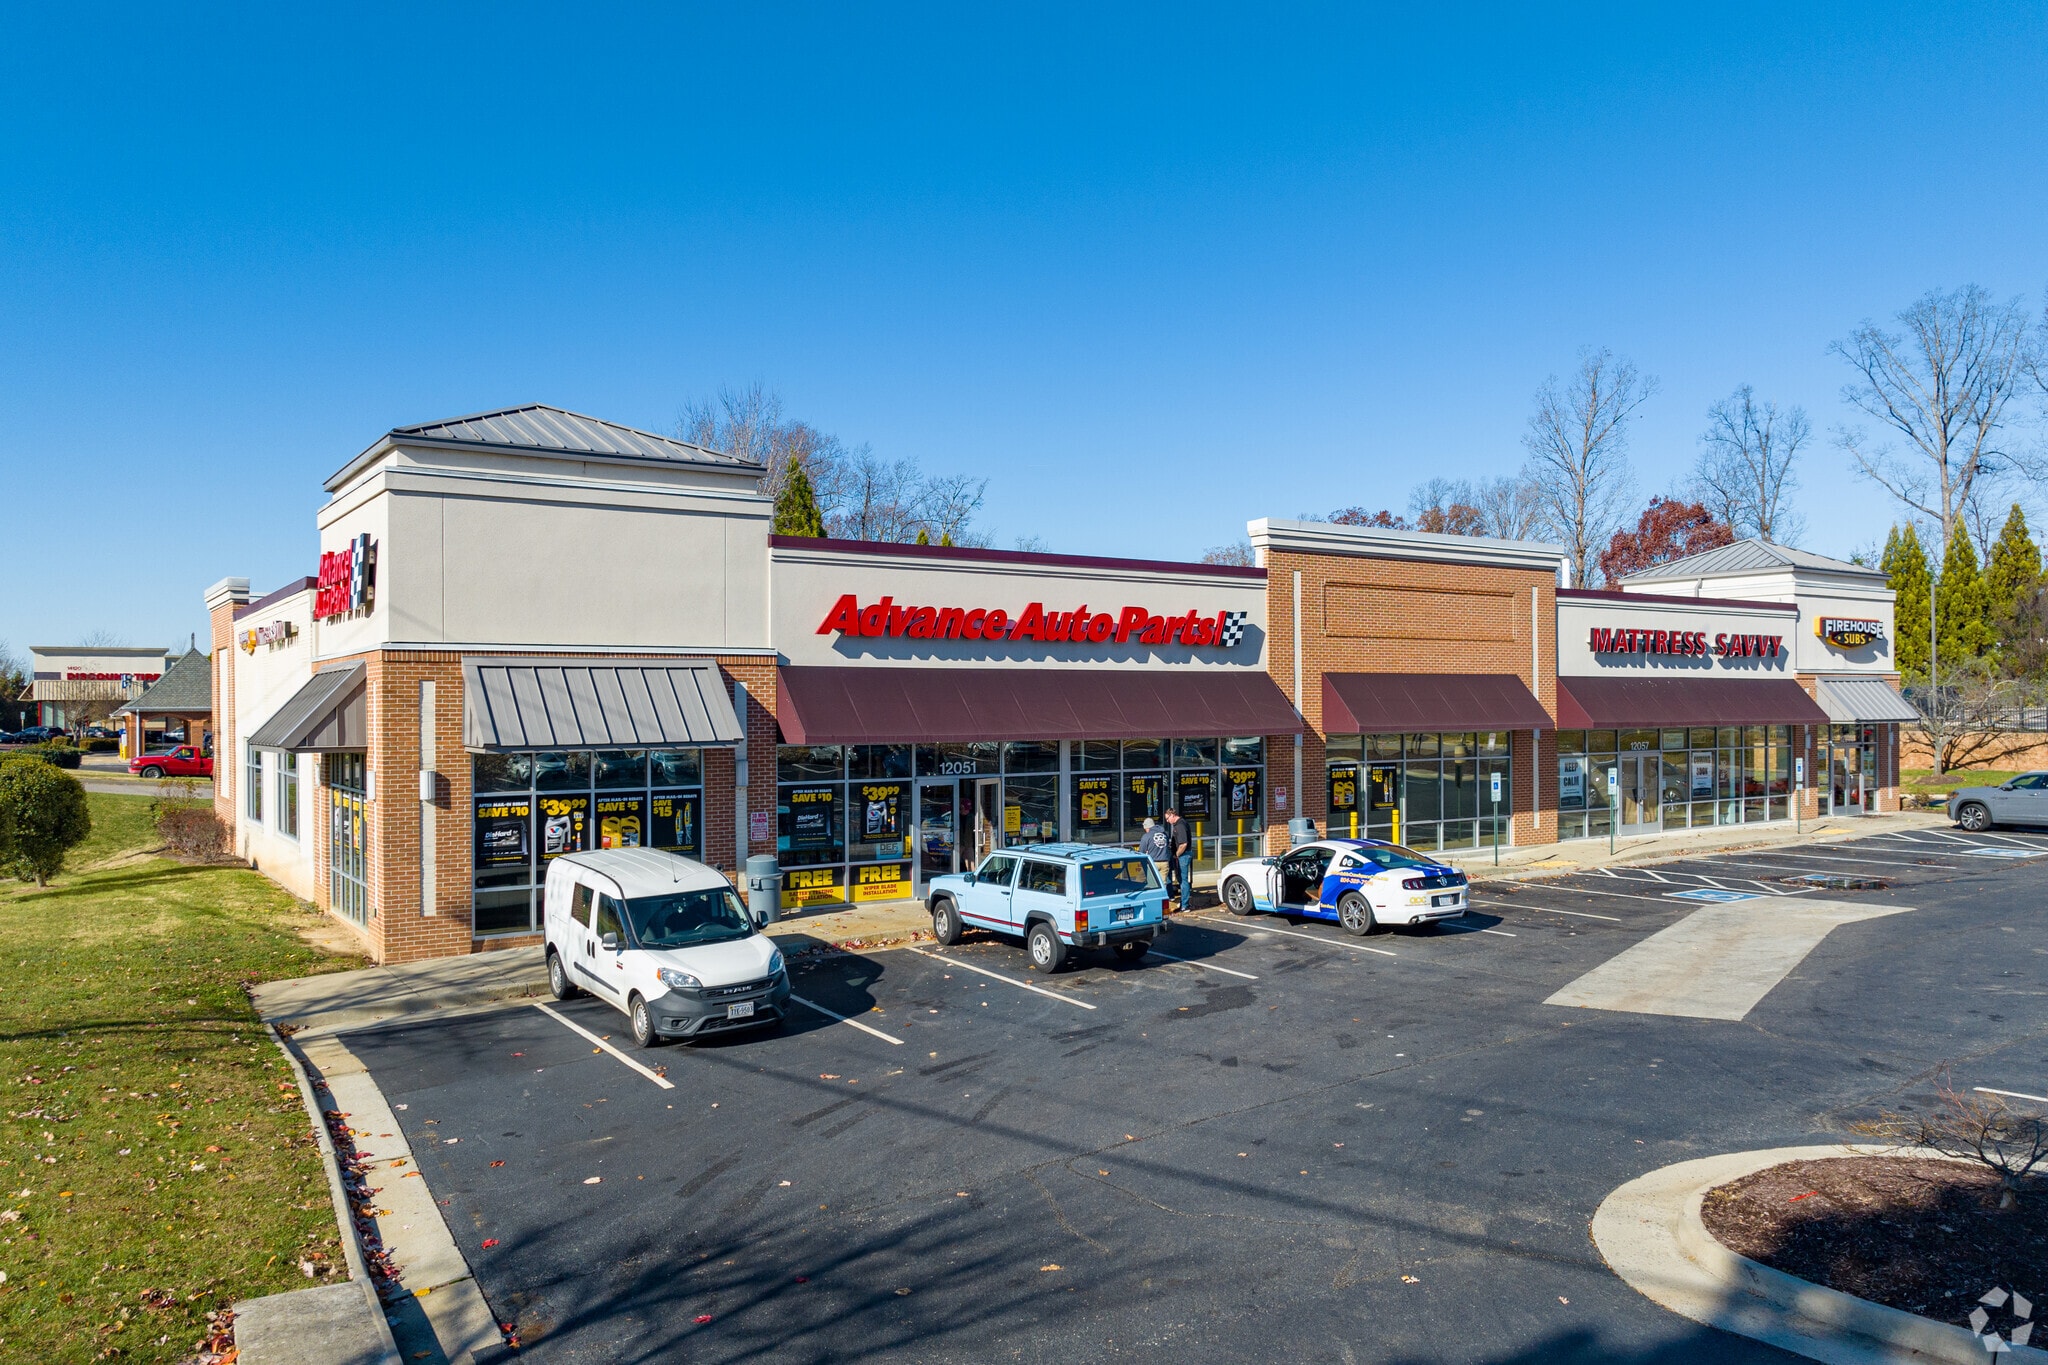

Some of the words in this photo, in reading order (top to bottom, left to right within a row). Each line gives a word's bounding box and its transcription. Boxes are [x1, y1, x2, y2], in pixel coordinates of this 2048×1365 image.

[315, 549, 351, 590] Advance
[815, 594, 1012, 640] Advance
[1008, 602, 1114, 643] Auto
[1825, 619, 1884, 639] FIREHOUSE
[1590, 627, 1707, 655] MATTRESS
[1715, 633, 1783, 657] SAVVY
[1843, 633, 1866, 645] SUBS
[1630, 741, 1649, 751] 12057
[940, 761, 977, 775] 12051
[1564, 762, 1578, 772] KEEP
[1348, 770, 1354, 778] $5
[1372, 775, 1383, 783] $15
[1080, 781, 1098, 790] SAVE
[1100, 781, 1107, 789] $5
[1181, 777, 1198, 785] SAVE
[1199, 776, 1209, 784] $10
[1563, 776, 1579, 786] CALM
[1132, 785, 1145, 793] $15
[653, 799, 672, 807] SAVE
[792, 794, 817, 803] SAVE
[817, 793, 833, 802] $10
[597, 802, 625, 812] SAVE
[627, 801, 639, 811] $5
[653, 806, 673, 817] $15
[478, 807, 509, 818] SAVE
[510, 806, 529, 817] $10
[485, 830, 512, 838] DieHard
[789, 869, 833, 889] FREE
[859, 864, 901, 884] FREE
[789, 889, 811, 897] BATTERY
[863, 888, 898, 896] INSTALLATION
[796, 894, 833, 902] INSTALLATION
